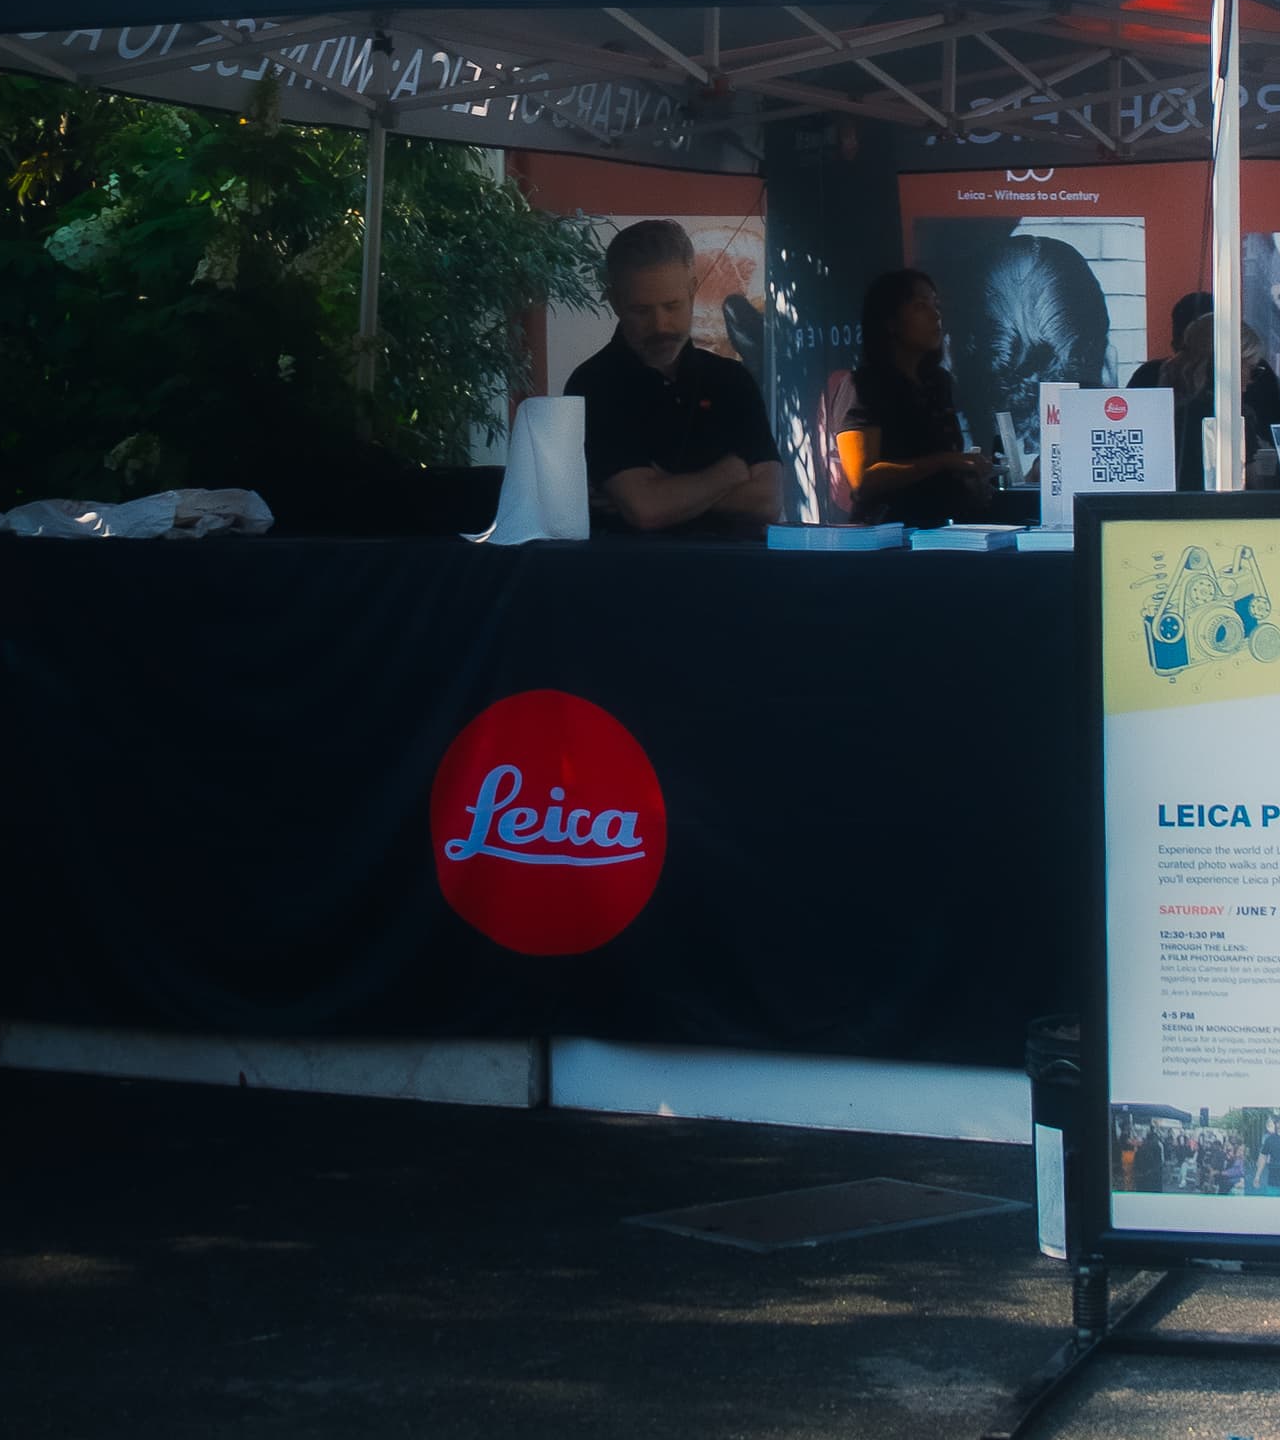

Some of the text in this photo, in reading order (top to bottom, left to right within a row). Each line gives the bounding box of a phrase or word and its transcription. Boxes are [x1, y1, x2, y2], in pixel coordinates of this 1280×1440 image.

[957, 190, 986, 201] Leica
[994, 189, 1036, 201] Witness
[1037, 191, 1049, 201] to
[1049, 193, 1058, 201] a
[1058, 190, 1100, 204] Century
[444, 764, 646, 867] Leica
[1158, 803, 1250, 828] LEICA
[1158, 845, 1212, 857] Experience
[1213, 845, 1231, 855] the
[1232, 845, 1261, 855] world
[1262, 845, 1274, 855] of
[1158, 860, 1195, 869] curated
[1197, 860, 1226, 872] photo
[1258, 860, 1279, 869] and
[1158, 875, 1184, 886] you'll
[1185, 875, 1240, 886] experience
[1241, 875, 1269, 884] Leica
[1159, 906, 1224, 915] SATURDAY
[1236, 906, 1267, 916] JUNE
[1270, 907, 1277, 916] 7
[1159, 931, 1225, 939] 12:30-1:30 PM
[1160, 943, 1248, 952] THROUGH THE LENS:
[1167, 954, 1188, 962] FILM
[1161, 1011, 1195, 1020] 4-5 PM
[1161, 1024, 1193, 1032] SEEING
[1205, 1025, 1271, 1033] MONOCHROME
